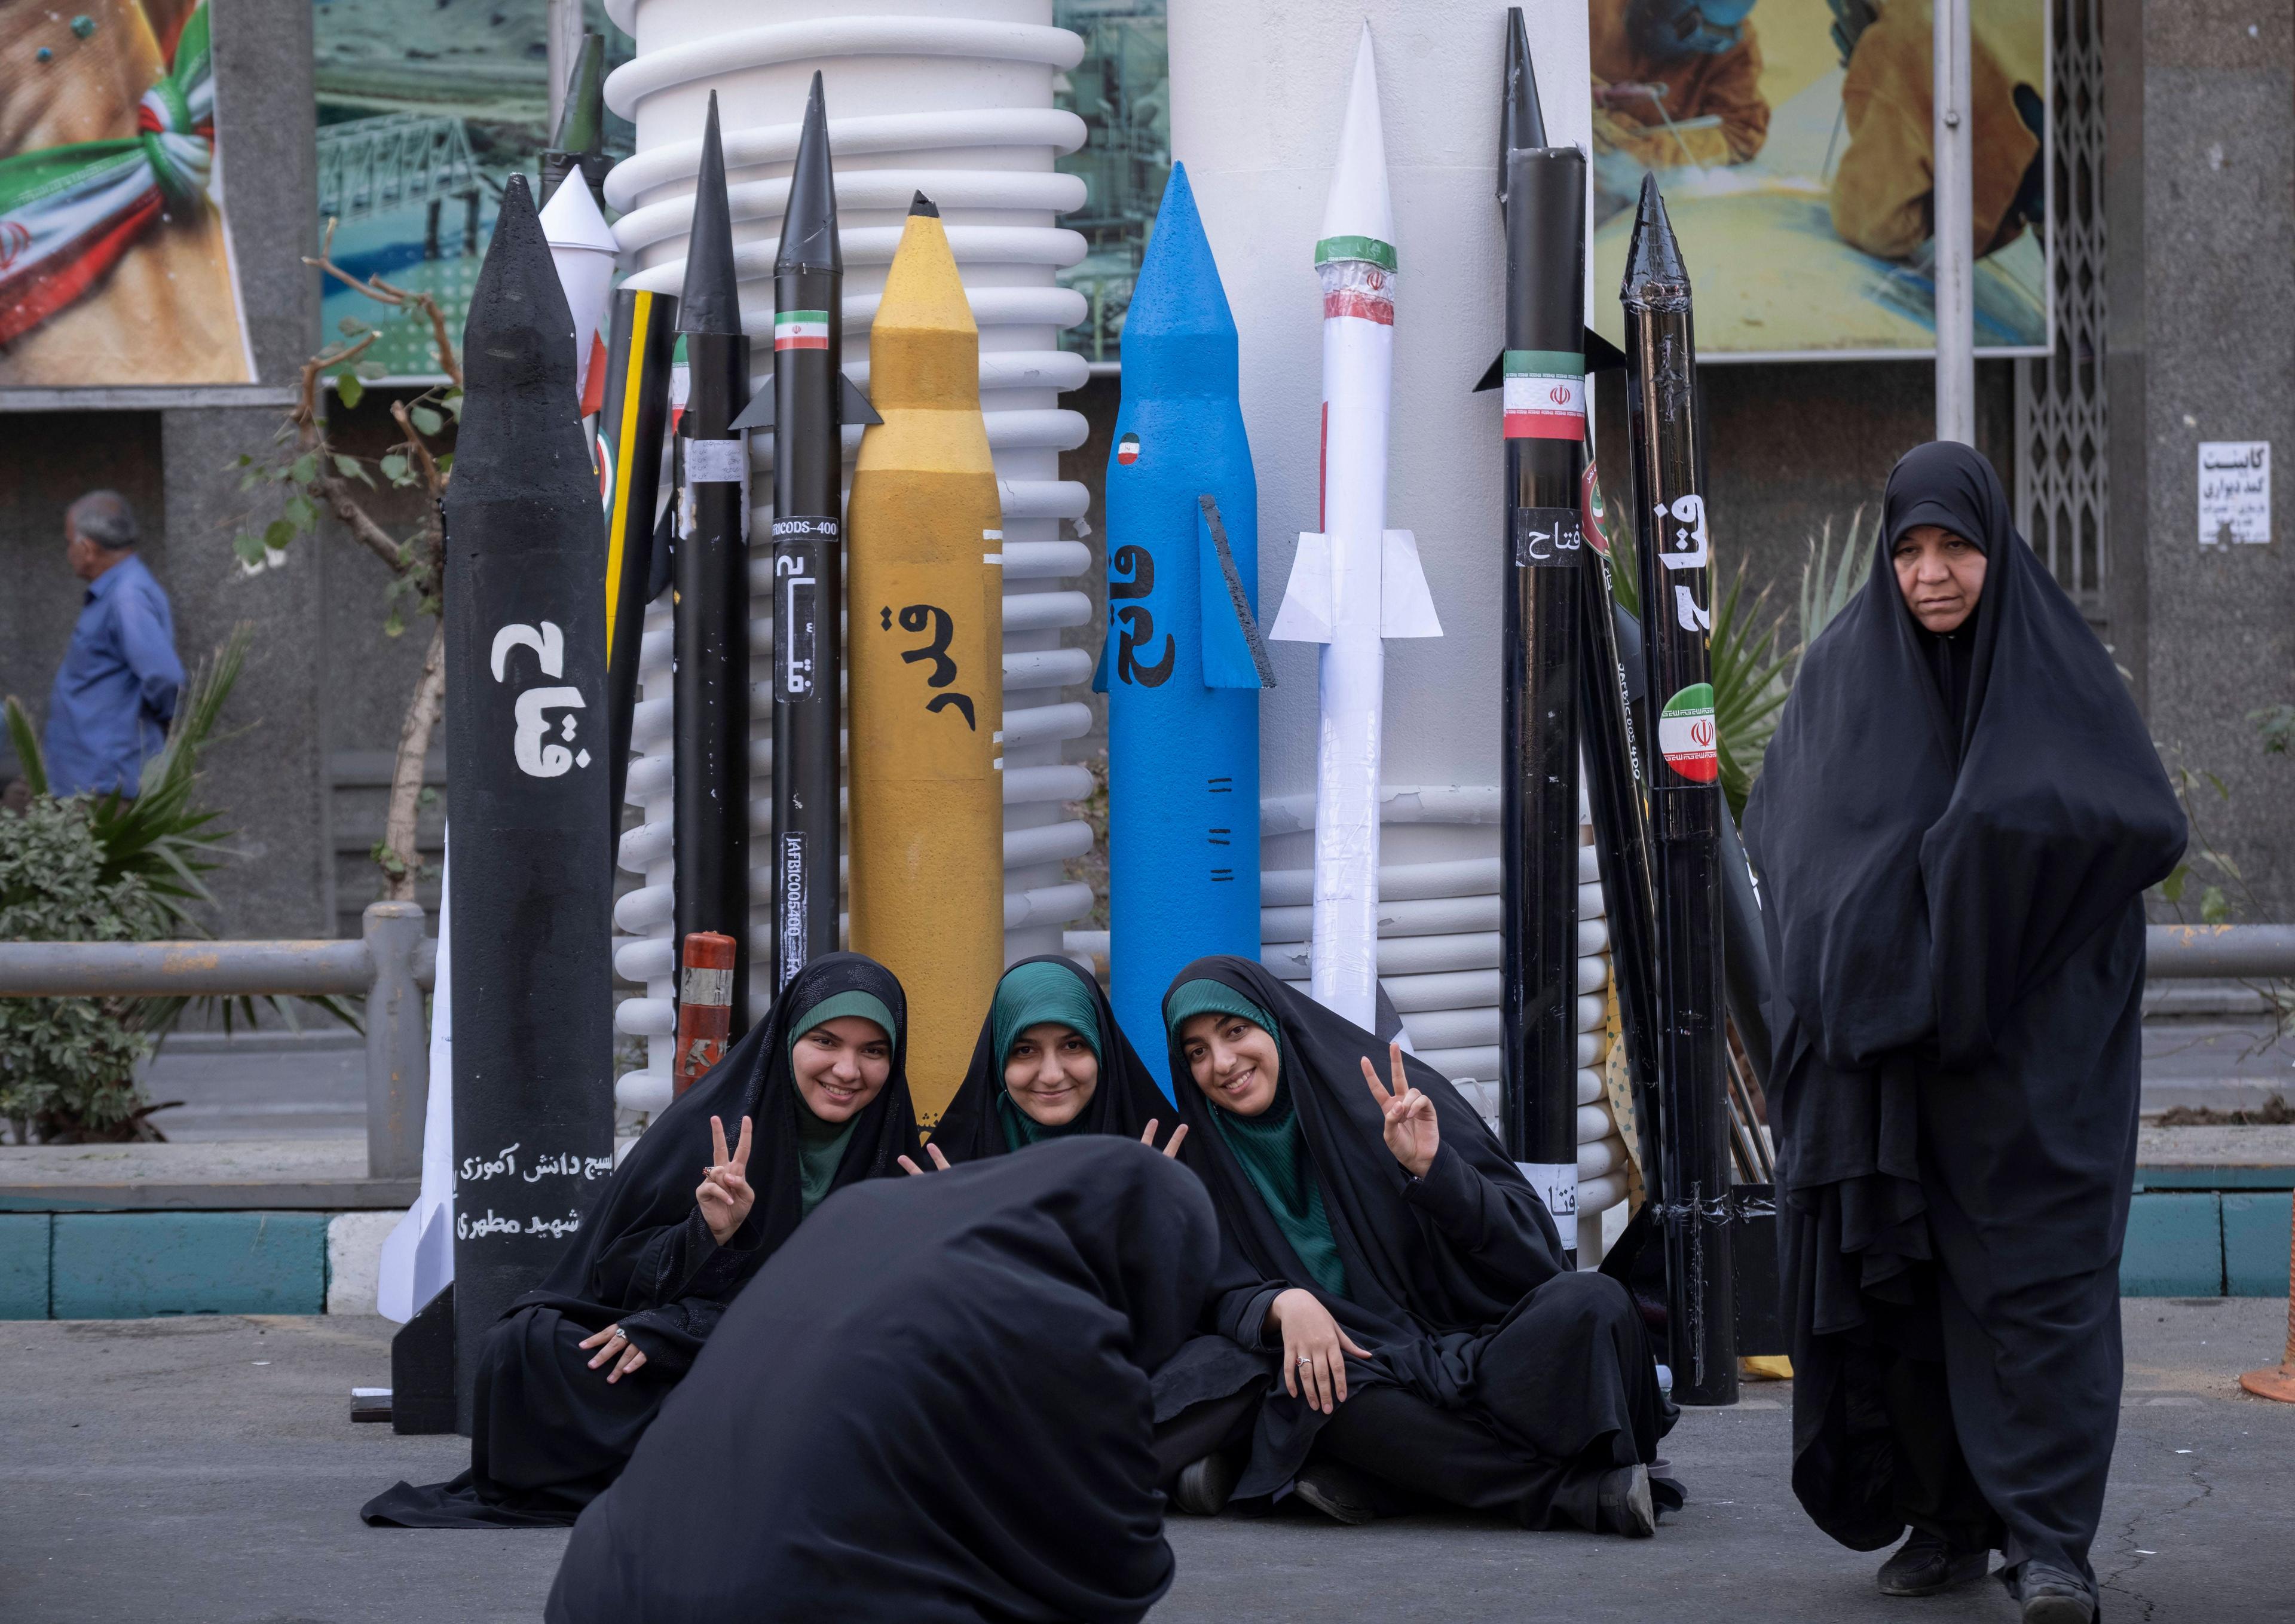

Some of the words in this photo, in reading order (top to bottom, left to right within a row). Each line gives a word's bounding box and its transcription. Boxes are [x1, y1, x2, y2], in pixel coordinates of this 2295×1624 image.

[1528, 520, 1581, 560] فتاح
[1107, 544, 1176, 688] فاتح
[879, 604, 977, 733] قدر
[490, 620, 592, 778] فتاح
[460, 1142, 521, 1181] آموزی
[523, 1151, 580, 1183] دانش
[1547, 1185, 1575, 1217] فتا
[457, 1209, 521, 1241] مطهری
[524, 1208, 580, 1239] شهید
